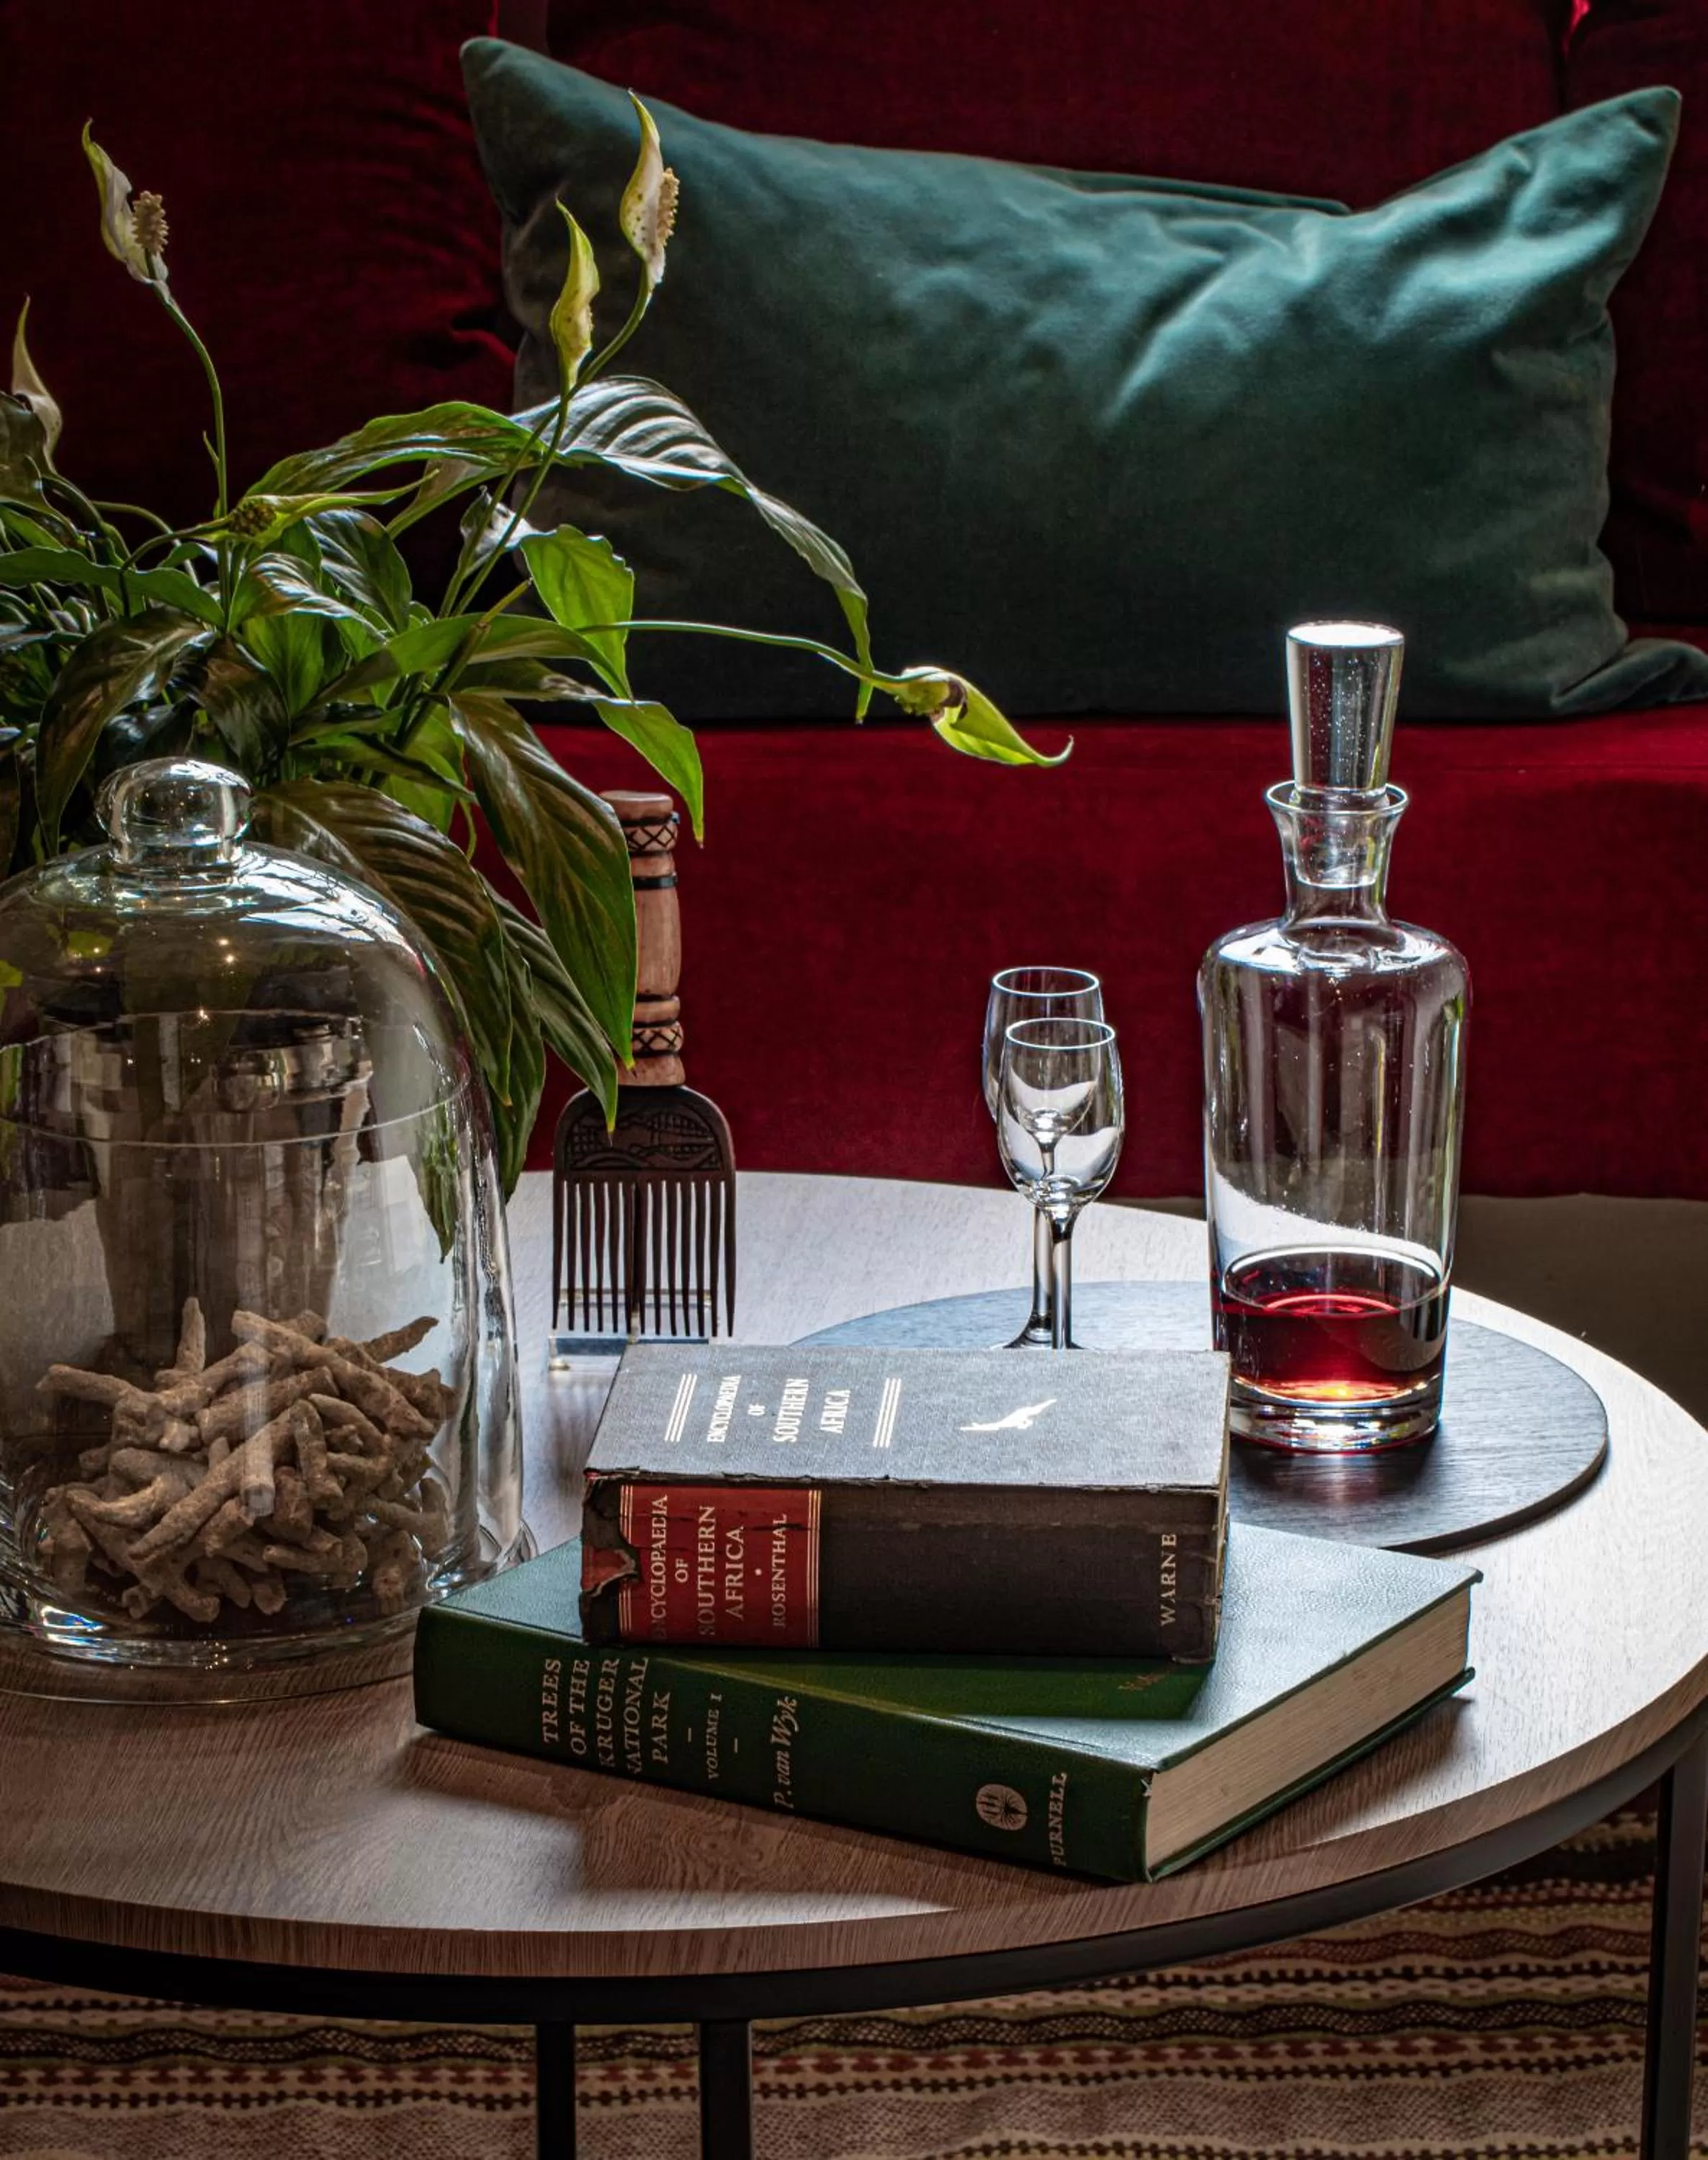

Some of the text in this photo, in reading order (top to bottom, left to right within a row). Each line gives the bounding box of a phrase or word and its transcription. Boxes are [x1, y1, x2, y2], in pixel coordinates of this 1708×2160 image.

[706, 1374, 742, 1443] ENCYCLOPAEDIA
[747, 1405, 765, 1417] OF
[773, 1379, 809, 1443] SOUTHERN
[820, 1390, 851, 1434] AFRICA
[650, 1494, 669, 1640] ECYCLOPAEDIA
[674, 1557, 689, 1583] OF
[697, 1505, 716, 1636] SOUTHERN
[724, 1526, 745, 1621] AFRICA
[771, 1513, 788, 1628] ROSENTHAL
[1160, 1532, 1177, 1626] WARNE
[542, 1658, 562, 1744] TREES
[569, 1659, 590, 1757] OF THE
[595, 1659, 620, 1768] KRUGER
[651, 1691, 670, 1765] PARK
[705, 1709, 722, 1780] VOLUME
[770, 1696, 799, 1810] P. van Wyk
[1048, 1772, 1069, 1868] PURNELL
